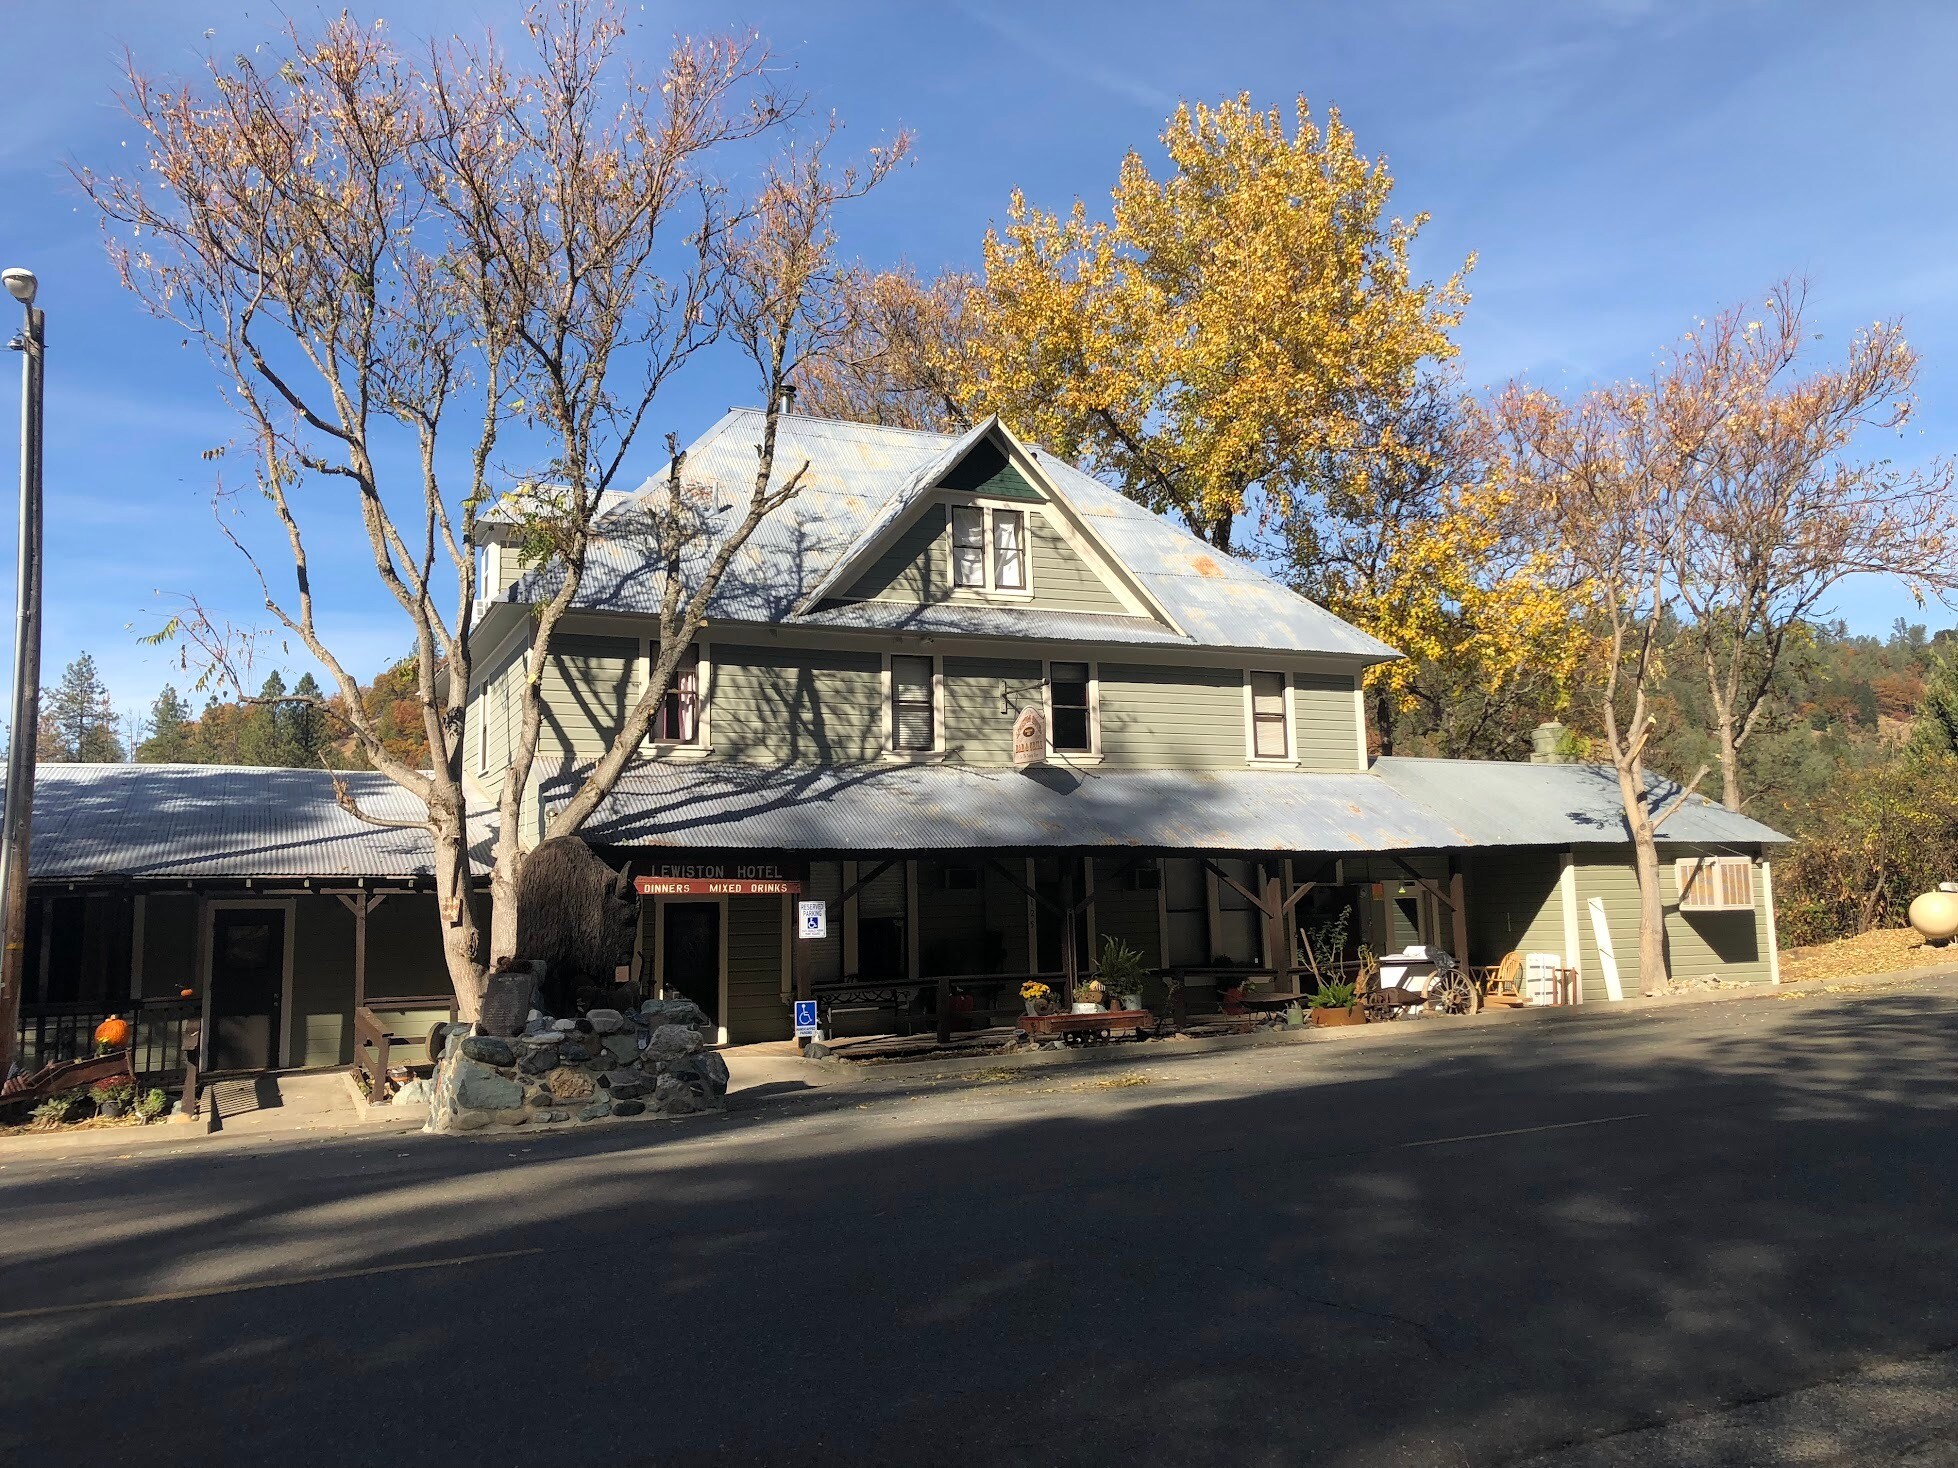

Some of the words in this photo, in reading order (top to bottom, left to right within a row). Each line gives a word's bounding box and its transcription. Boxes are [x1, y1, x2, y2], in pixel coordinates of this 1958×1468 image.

[651, 864, 724, 878] LEWISTON
[738, 865, 782, 878] HOTEL
[644, 884, 690, 893] DINNERS
[709, 884, 742, 893] MIXED
[751, 883, 788, 893] DRINKS
[800, 903, 824, 911] RESERVED
[803, 909, 823, 917] PARKING
